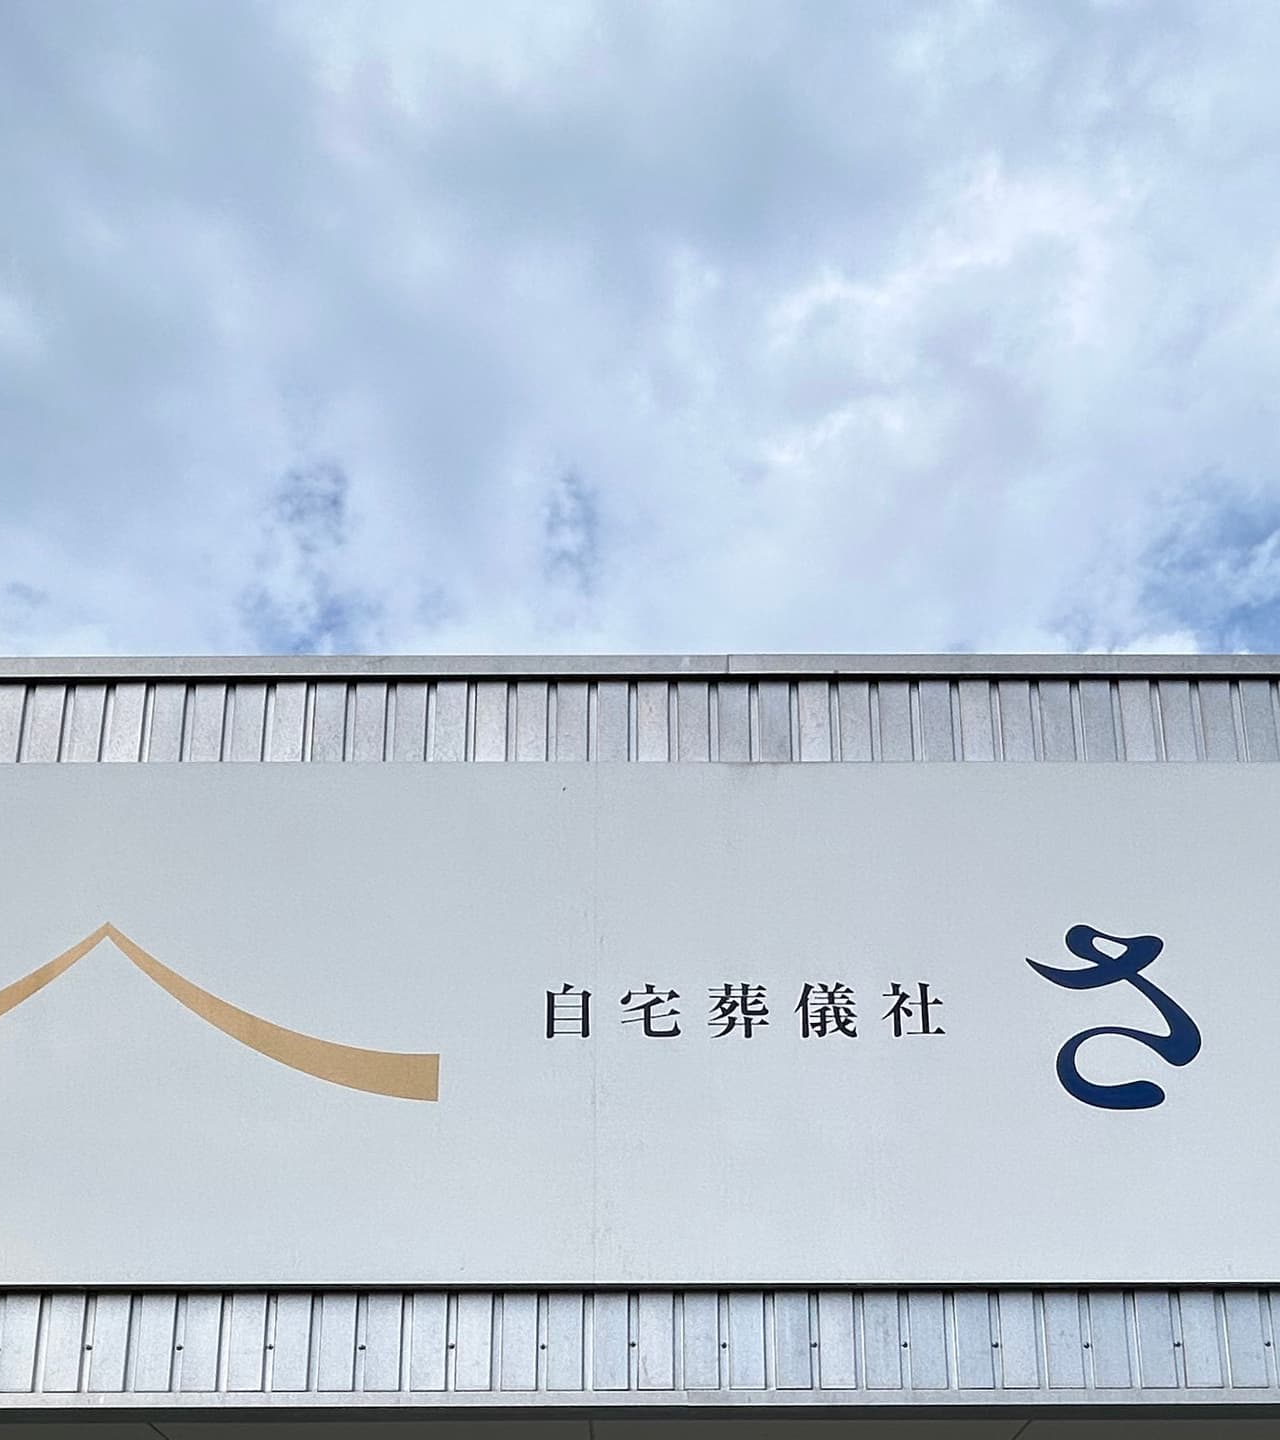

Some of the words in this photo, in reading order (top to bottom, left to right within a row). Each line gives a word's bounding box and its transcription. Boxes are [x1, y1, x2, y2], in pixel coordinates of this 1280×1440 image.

[544, 981, 947, 1040] 自宅葬儀社
